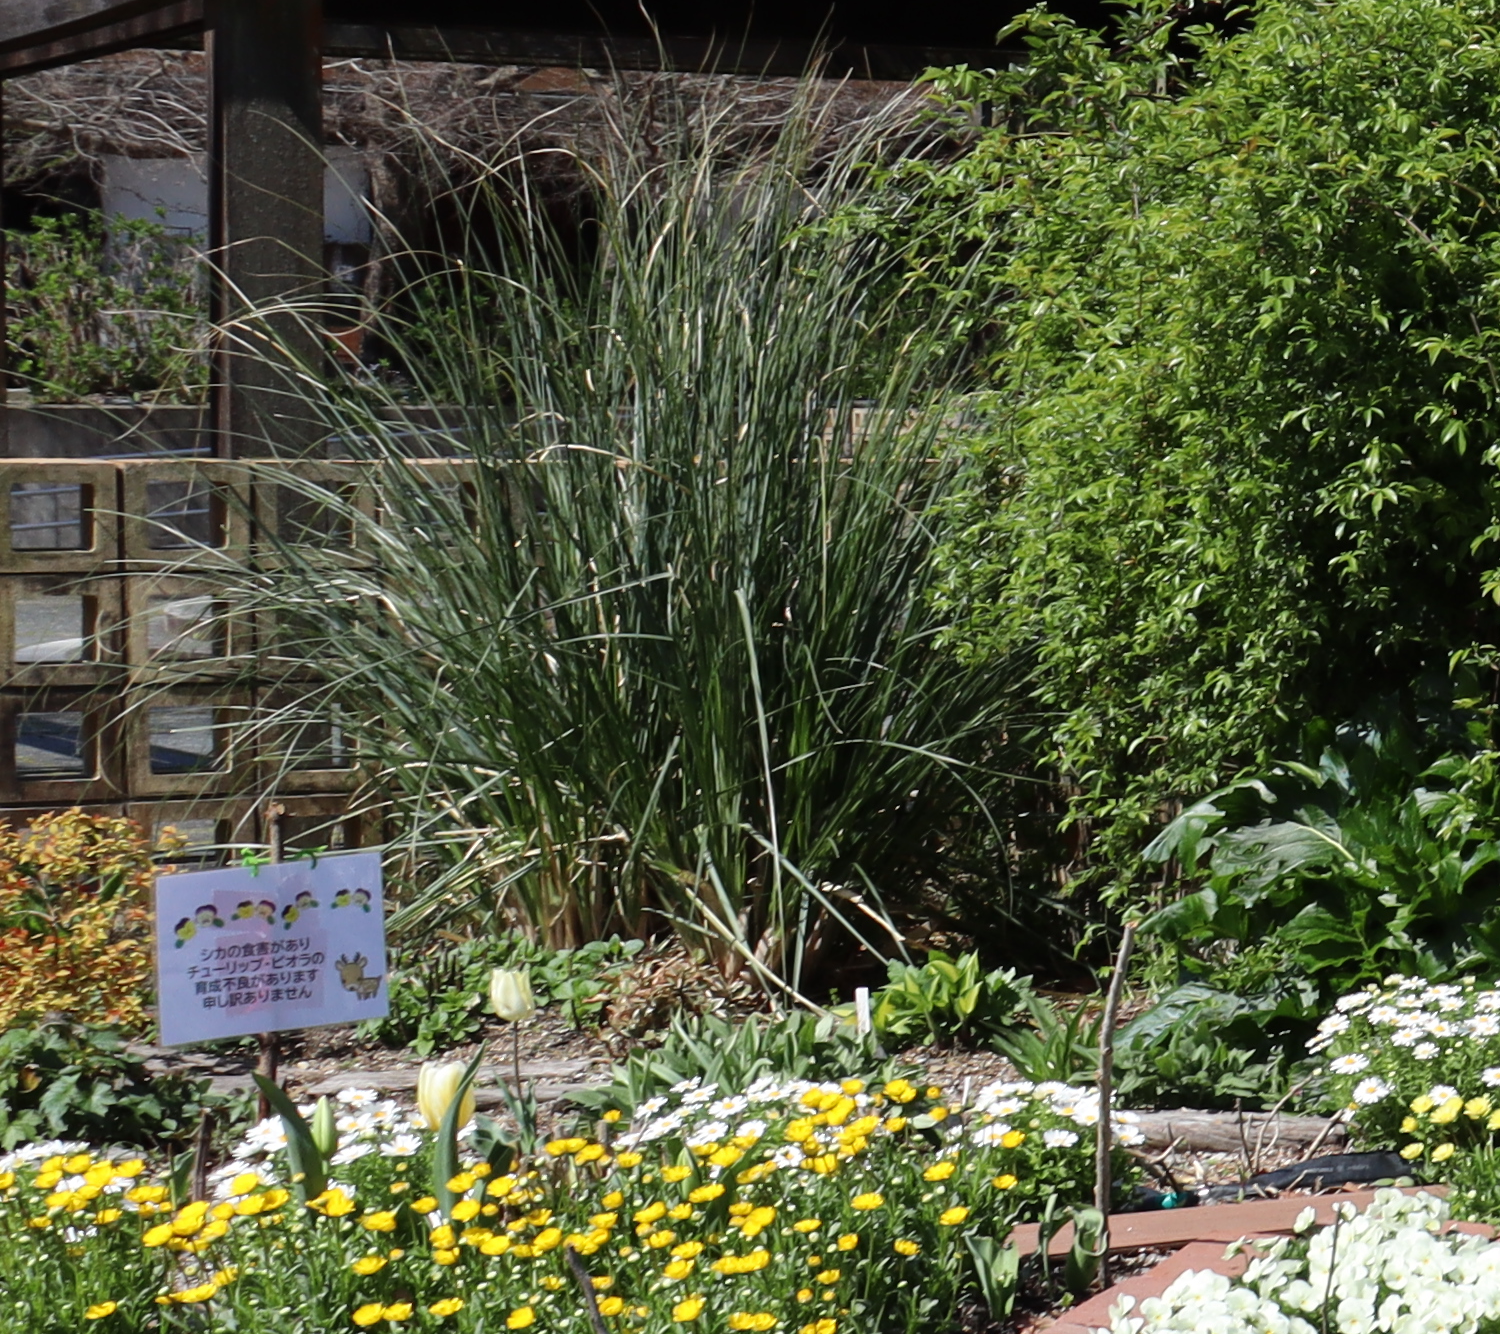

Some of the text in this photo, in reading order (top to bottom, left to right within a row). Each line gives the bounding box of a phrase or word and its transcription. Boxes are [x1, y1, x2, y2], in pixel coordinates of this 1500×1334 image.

[200, 937, 310, 961] シカの食害があり
[195, 969, 318, 995] 育成不良があります
[203, 986, 312, 1009] 申し訳ありません
